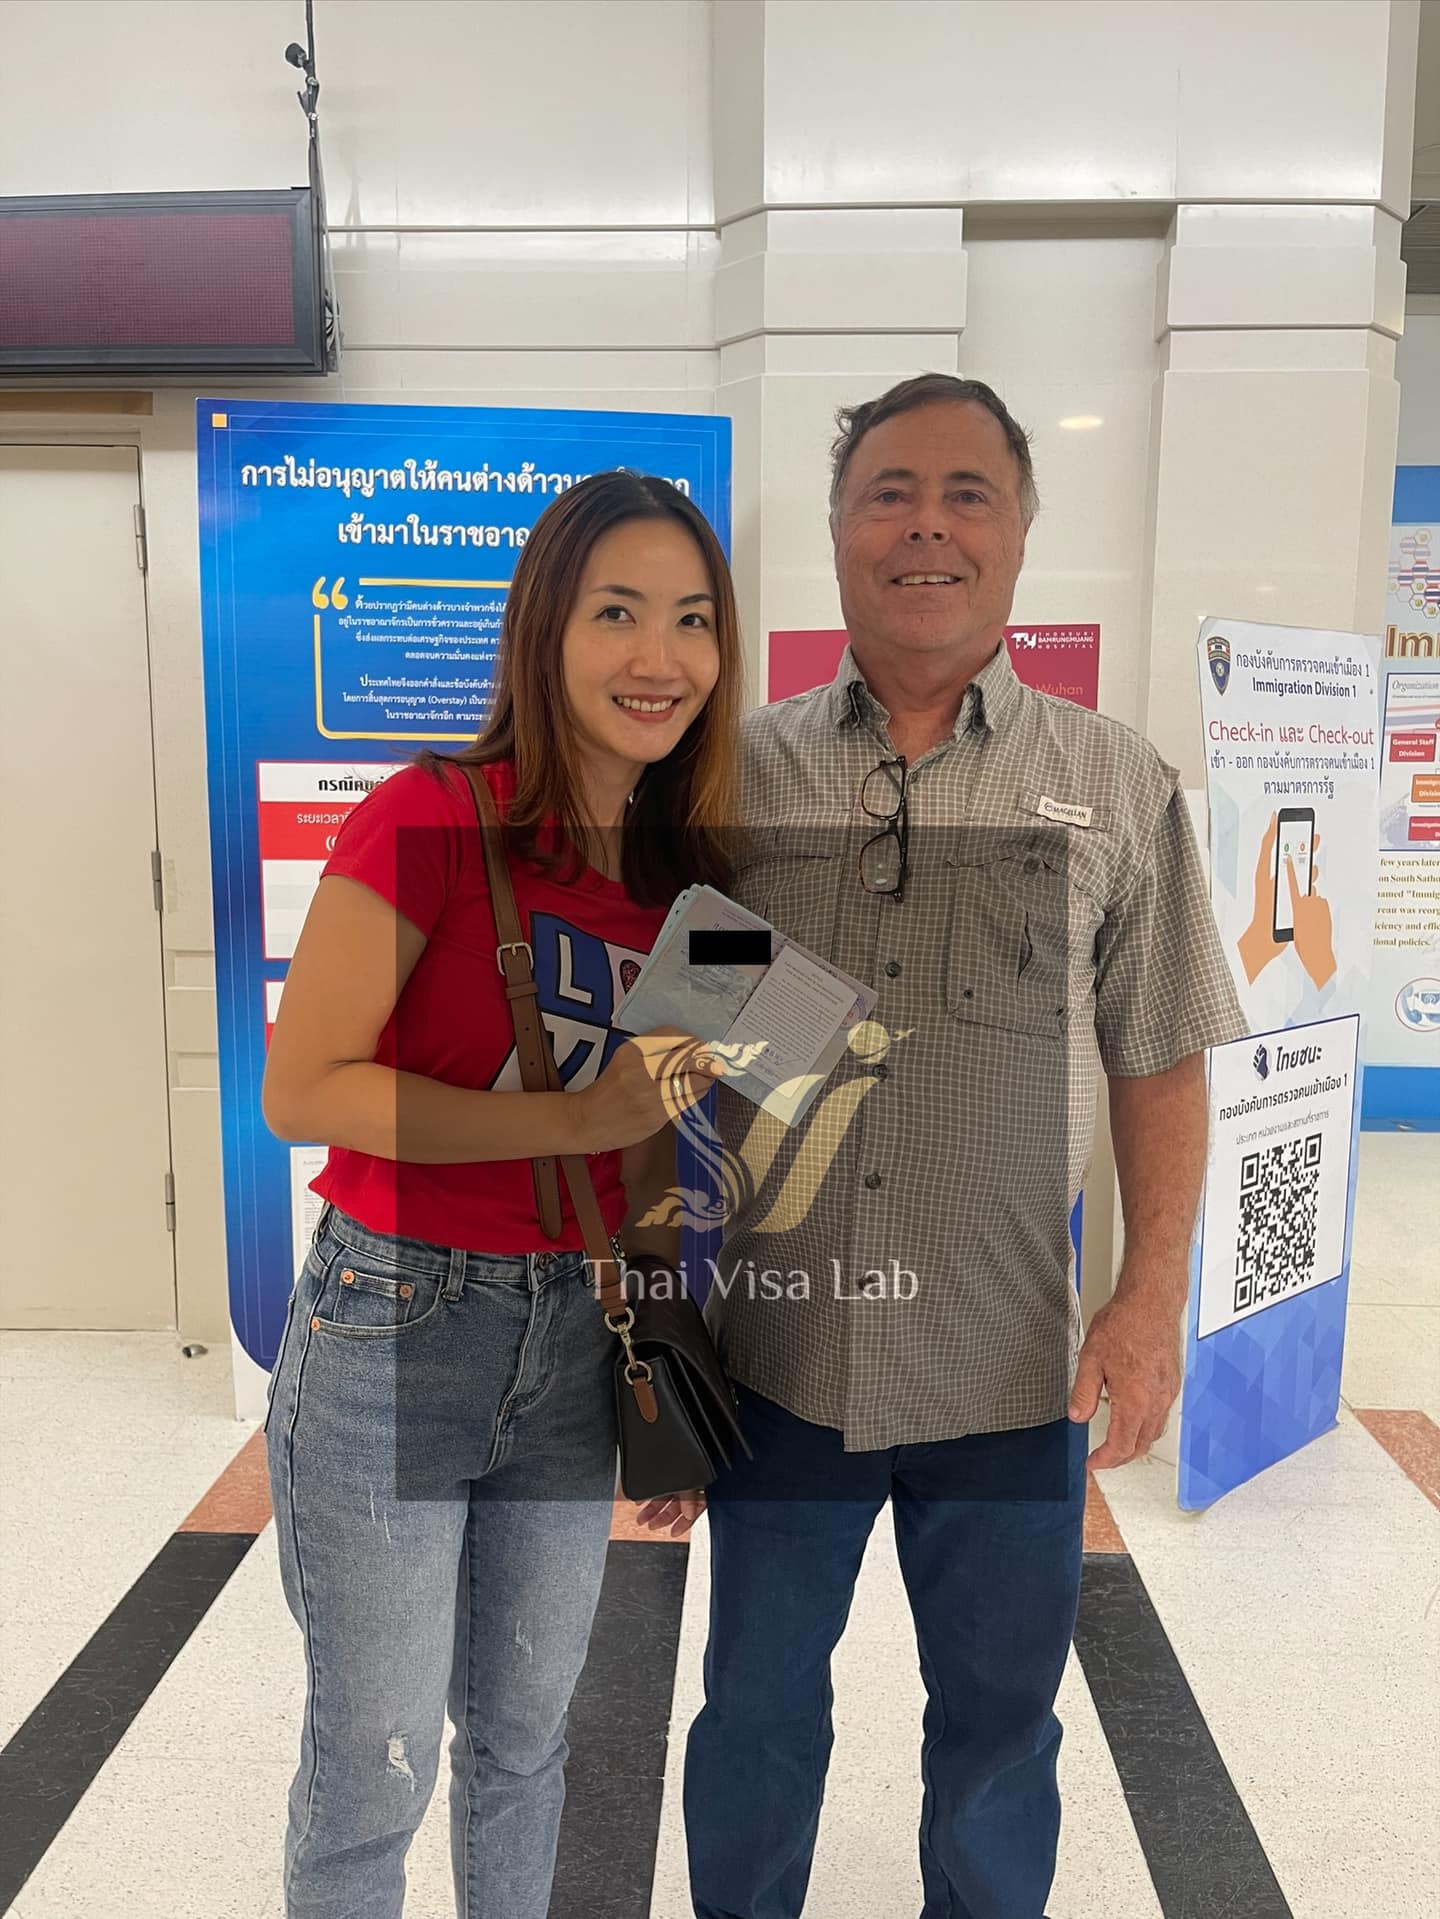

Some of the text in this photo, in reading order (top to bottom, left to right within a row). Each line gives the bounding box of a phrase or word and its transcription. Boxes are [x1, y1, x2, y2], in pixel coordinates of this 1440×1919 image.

[1385, 625, 1440, 659] Im
[1236, 649, 1370, 677] กองบังคับการตรวจคนเข้าเมือง 1
[1252, 677, 1357, 698] Immigration Division 1
[1209, 720, 1375, 745] Check-in และ Check-out
[1211, 750, 1226, 769] เข้า
[1236, 755, 1254, 769] ออก
[1370, 758, 1375, 770] 1
[1264, 776, 1335, 799] ตามมาตรการรัฐ
[1390, 874, 1415, 882] South
[1276, 1046, 1322, 1072] ไทยชนะ
[1219, 1076, 1341, 1120] กองบังคับการตรวจคนเข้าเมือง
